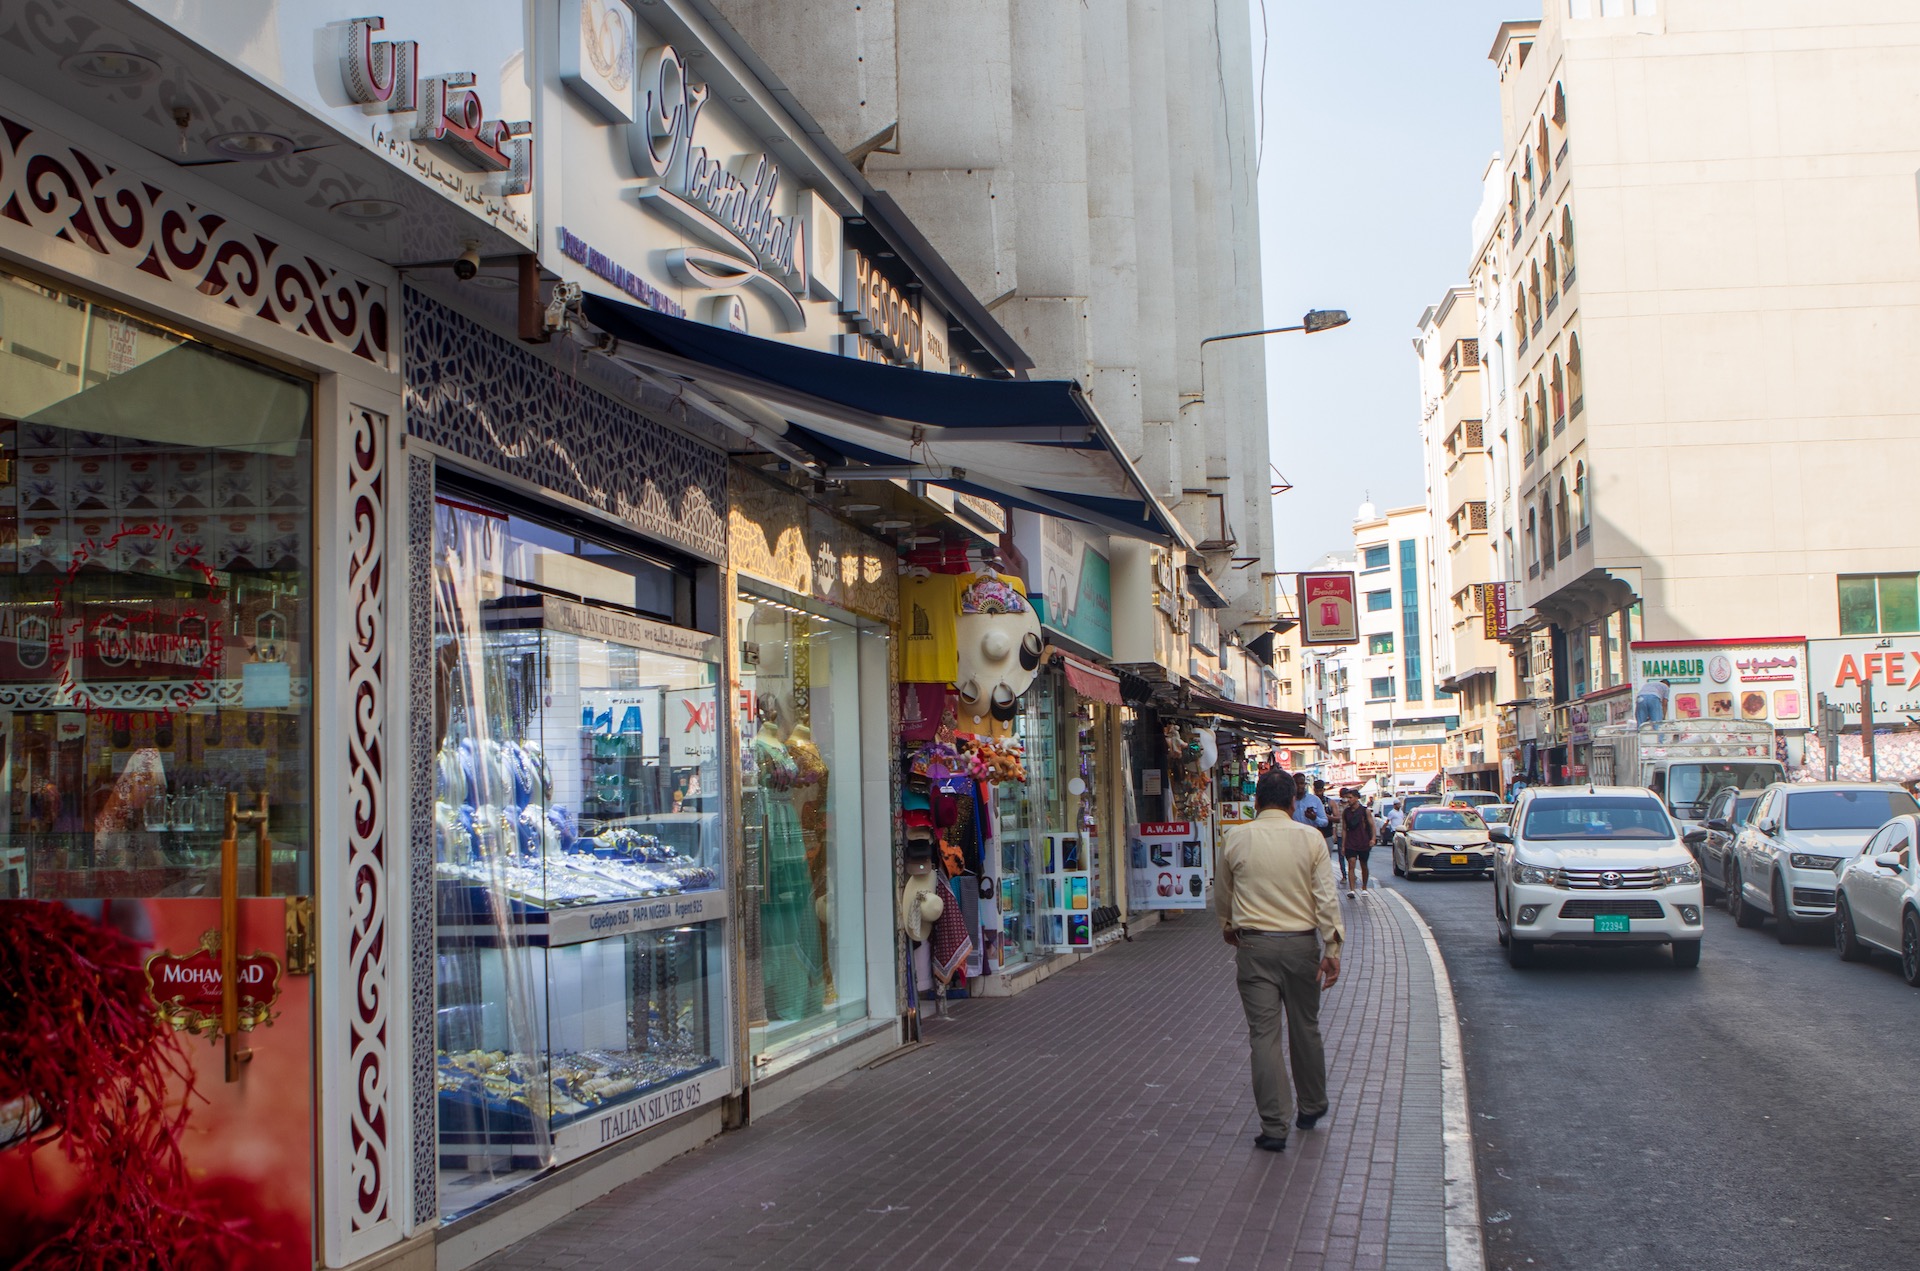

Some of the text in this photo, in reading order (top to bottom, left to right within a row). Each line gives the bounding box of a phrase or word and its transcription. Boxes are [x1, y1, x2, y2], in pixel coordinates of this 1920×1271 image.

[562, 606, 641, 642] ITALIAN SILVER 925
[1642, 659, 1705, 677] MAHABUB
[1735, 655, 1798, 675] محبوب
[1395, 760, 1434, 769] KHALIS
[1146, 825, 1185, 834] A.W.A.M
[633, 903, 672, 923] PAPA NIGERIA
[675, 899, 703, 919] Argent 925
[590, 909, 630, 932] Серебро 925
[1600, 921, 1624, 931] 22394
[163, 964, 264, 984] MOHAMAD
[600, 1082, 701, 1143] ITALIAN SILVER 925
